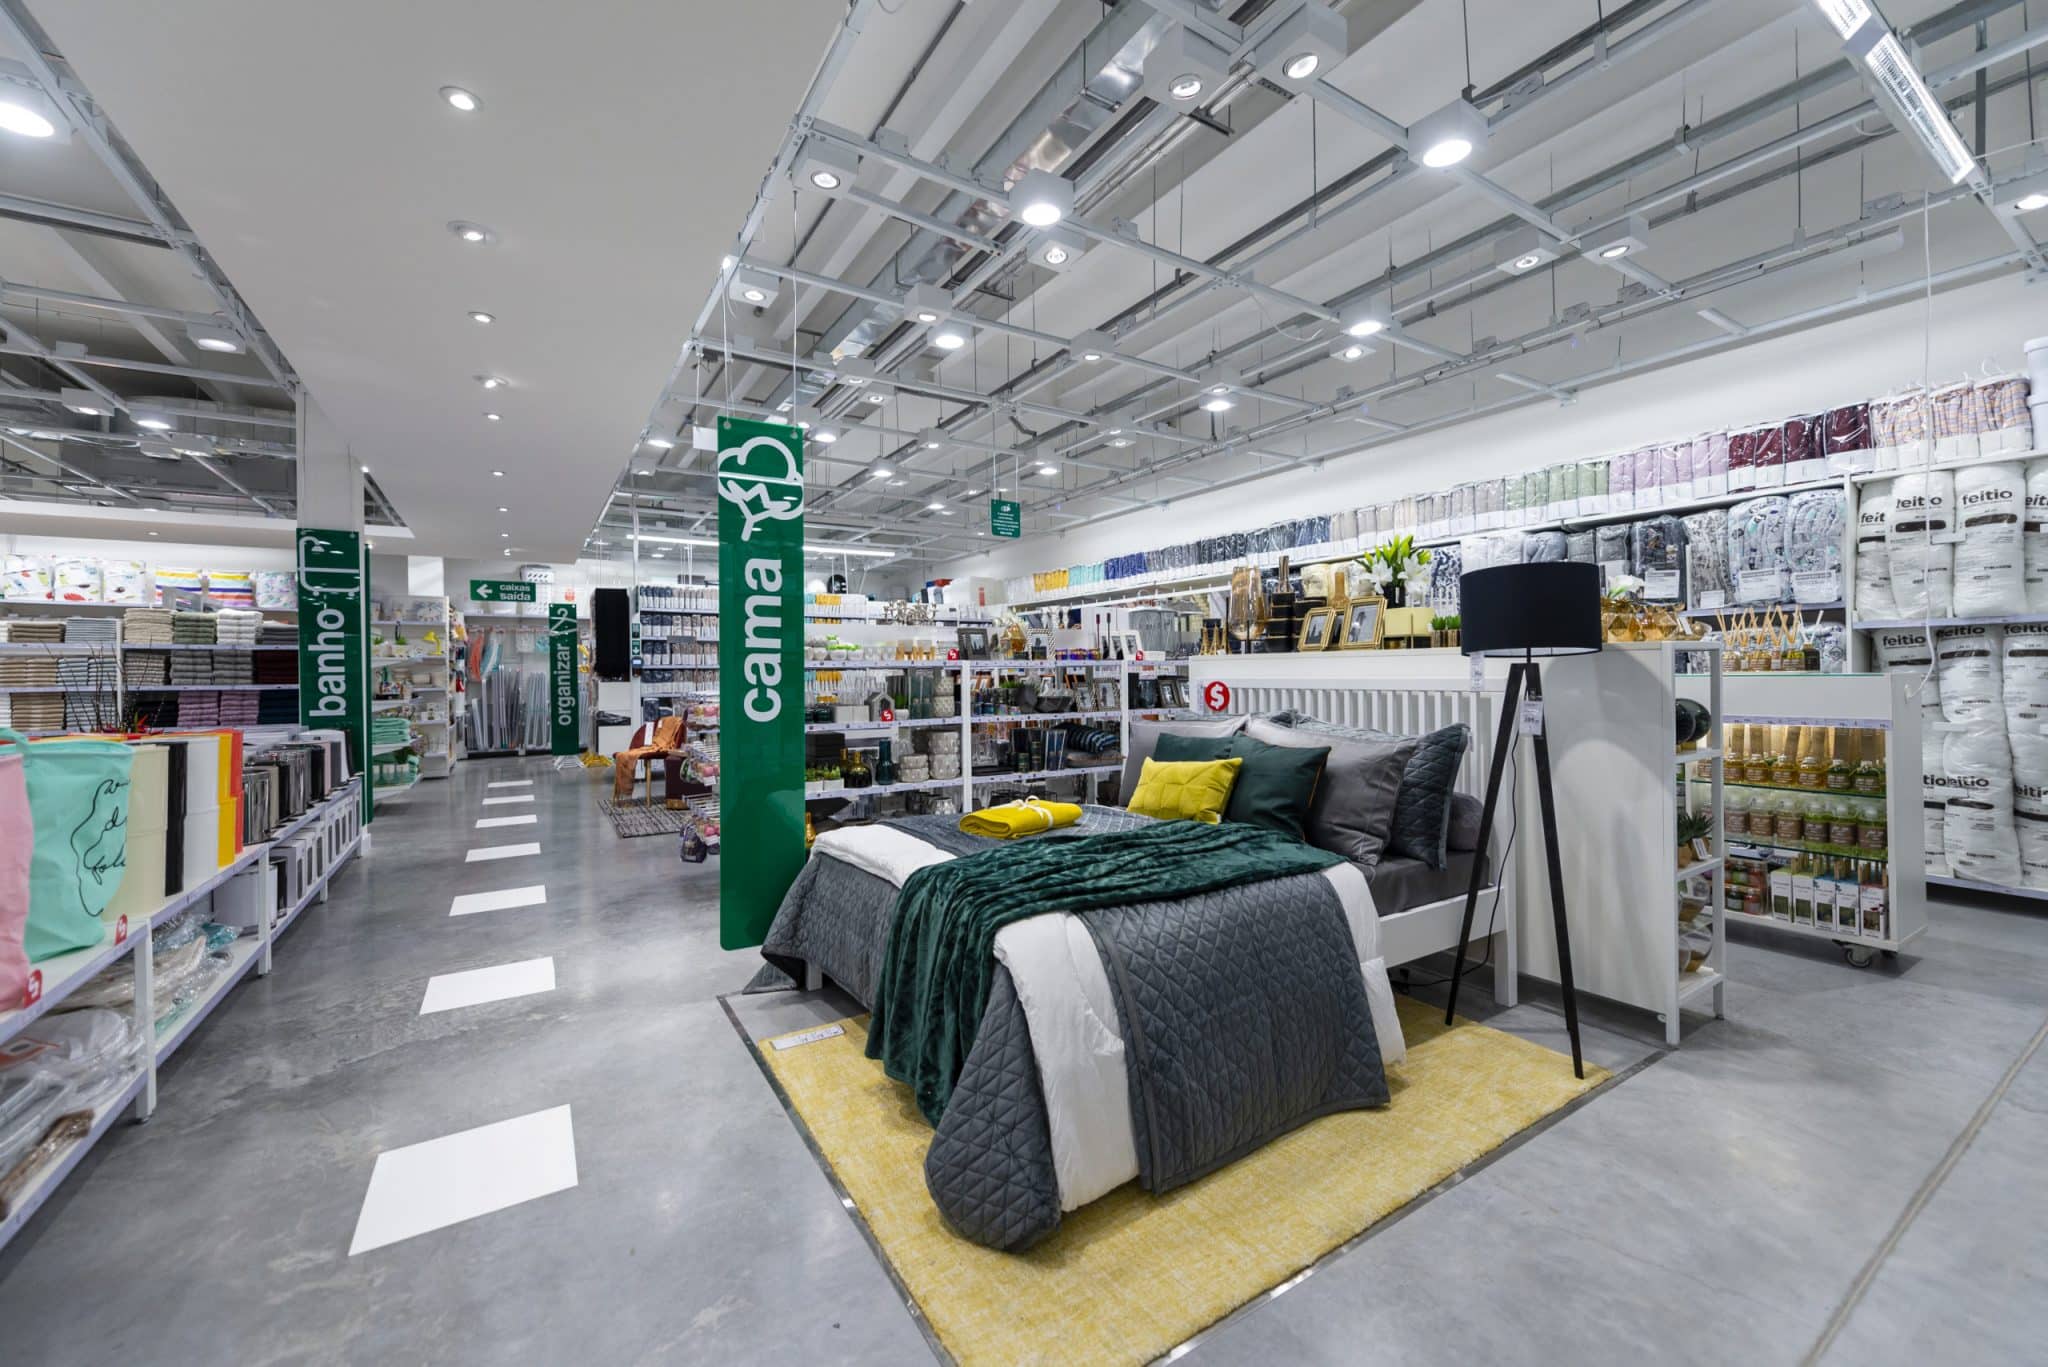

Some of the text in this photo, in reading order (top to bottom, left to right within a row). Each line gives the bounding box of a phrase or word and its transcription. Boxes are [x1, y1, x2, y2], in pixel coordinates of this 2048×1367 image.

[1962, 489, 2013, 505] feitio
[499, 583, 531, 592] caixas
[499, 591, 532, 601] saída
[743, 557, 783, 723] cama
[1882, 634, 1927, 647] feitio
[307, 608, 347, 717] banho
[553, 642, 576, 726] organizar
